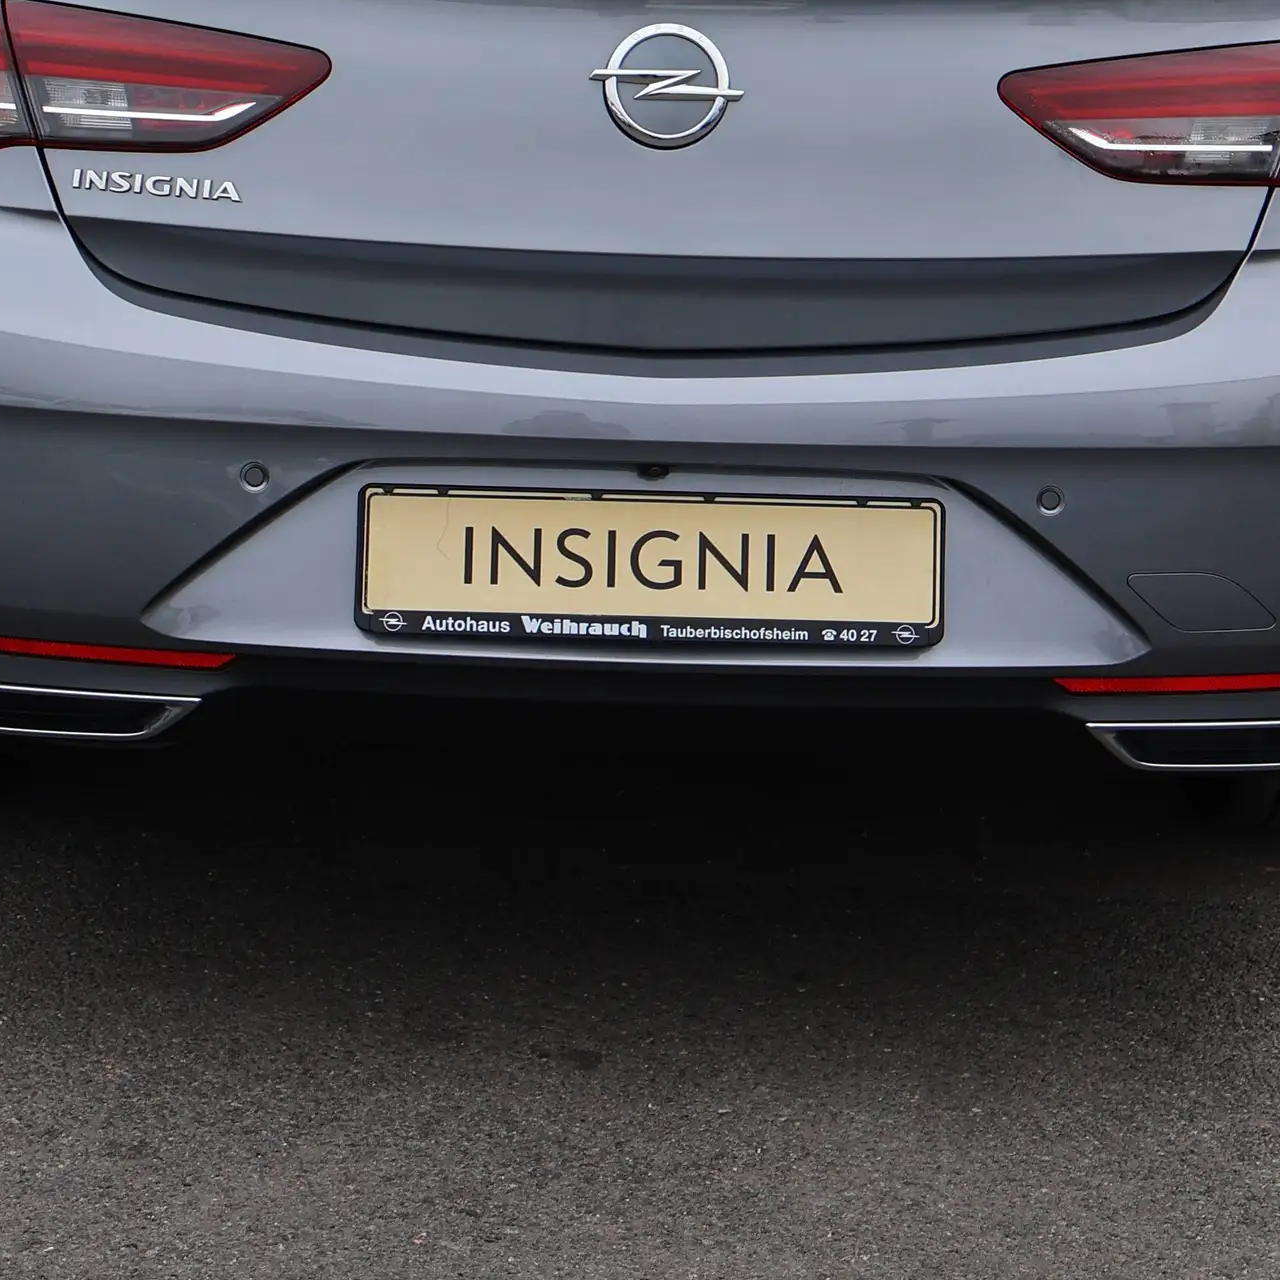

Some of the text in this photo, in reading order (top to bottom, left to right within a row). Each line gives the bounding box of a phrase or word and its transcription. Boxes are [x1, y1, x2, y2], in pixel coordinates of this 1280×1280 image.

[630, 24, 707, 43] OPEL
[71, 168, 242, 203] INSIGNIA
[463, 525, 844, 595] INSIGNIA
[421, 615, 878, 642] Autohaus Weihrauch Tauberbischofsheim 40 27
